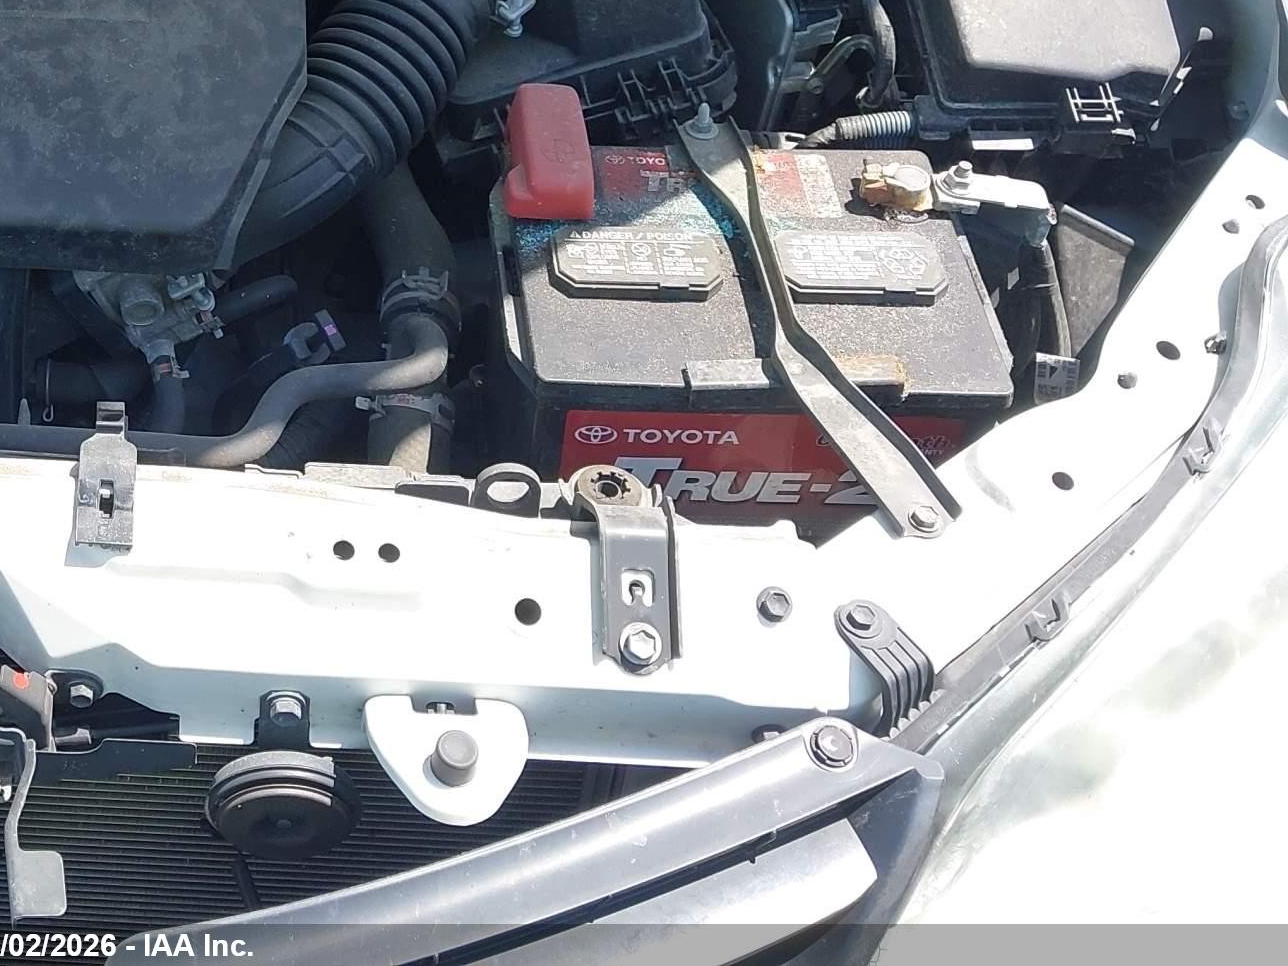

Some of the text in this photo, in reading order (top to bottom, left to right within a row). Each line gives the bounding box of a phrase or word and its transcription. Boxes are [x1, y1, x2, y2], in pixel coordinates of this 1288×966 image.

[627, 156, 666, 166] TOYO
[581, 230, 633, 240] DANGER
[646, 231, 694, 241] POISON
[623, 428, 740, 445] TOYOTA
